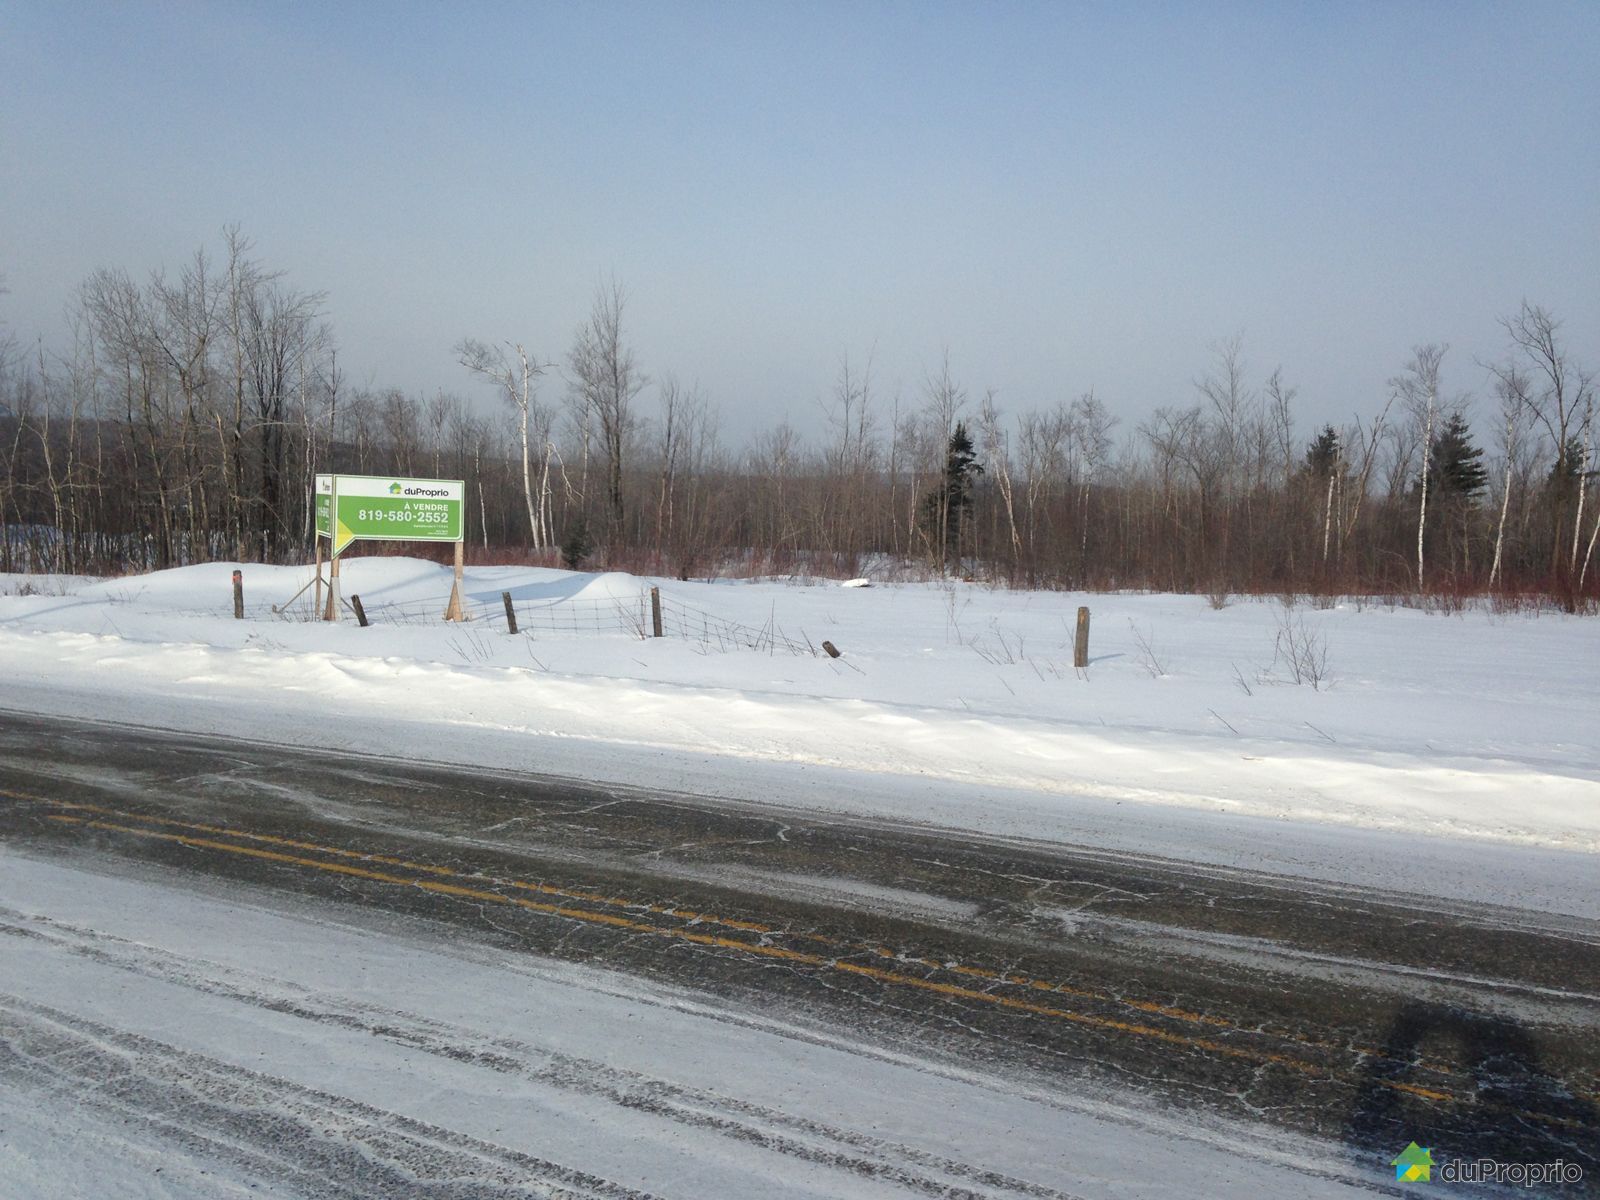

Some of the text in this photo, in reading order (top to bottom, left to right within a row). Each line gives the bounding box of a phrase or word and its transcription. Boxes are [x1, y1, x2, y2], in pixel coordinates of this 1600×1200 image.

[404, 487, 449, 497] duProprio
[413, 503, 449, 511] VENDRE
[358, 510, 449, 523] 819-580-2552
